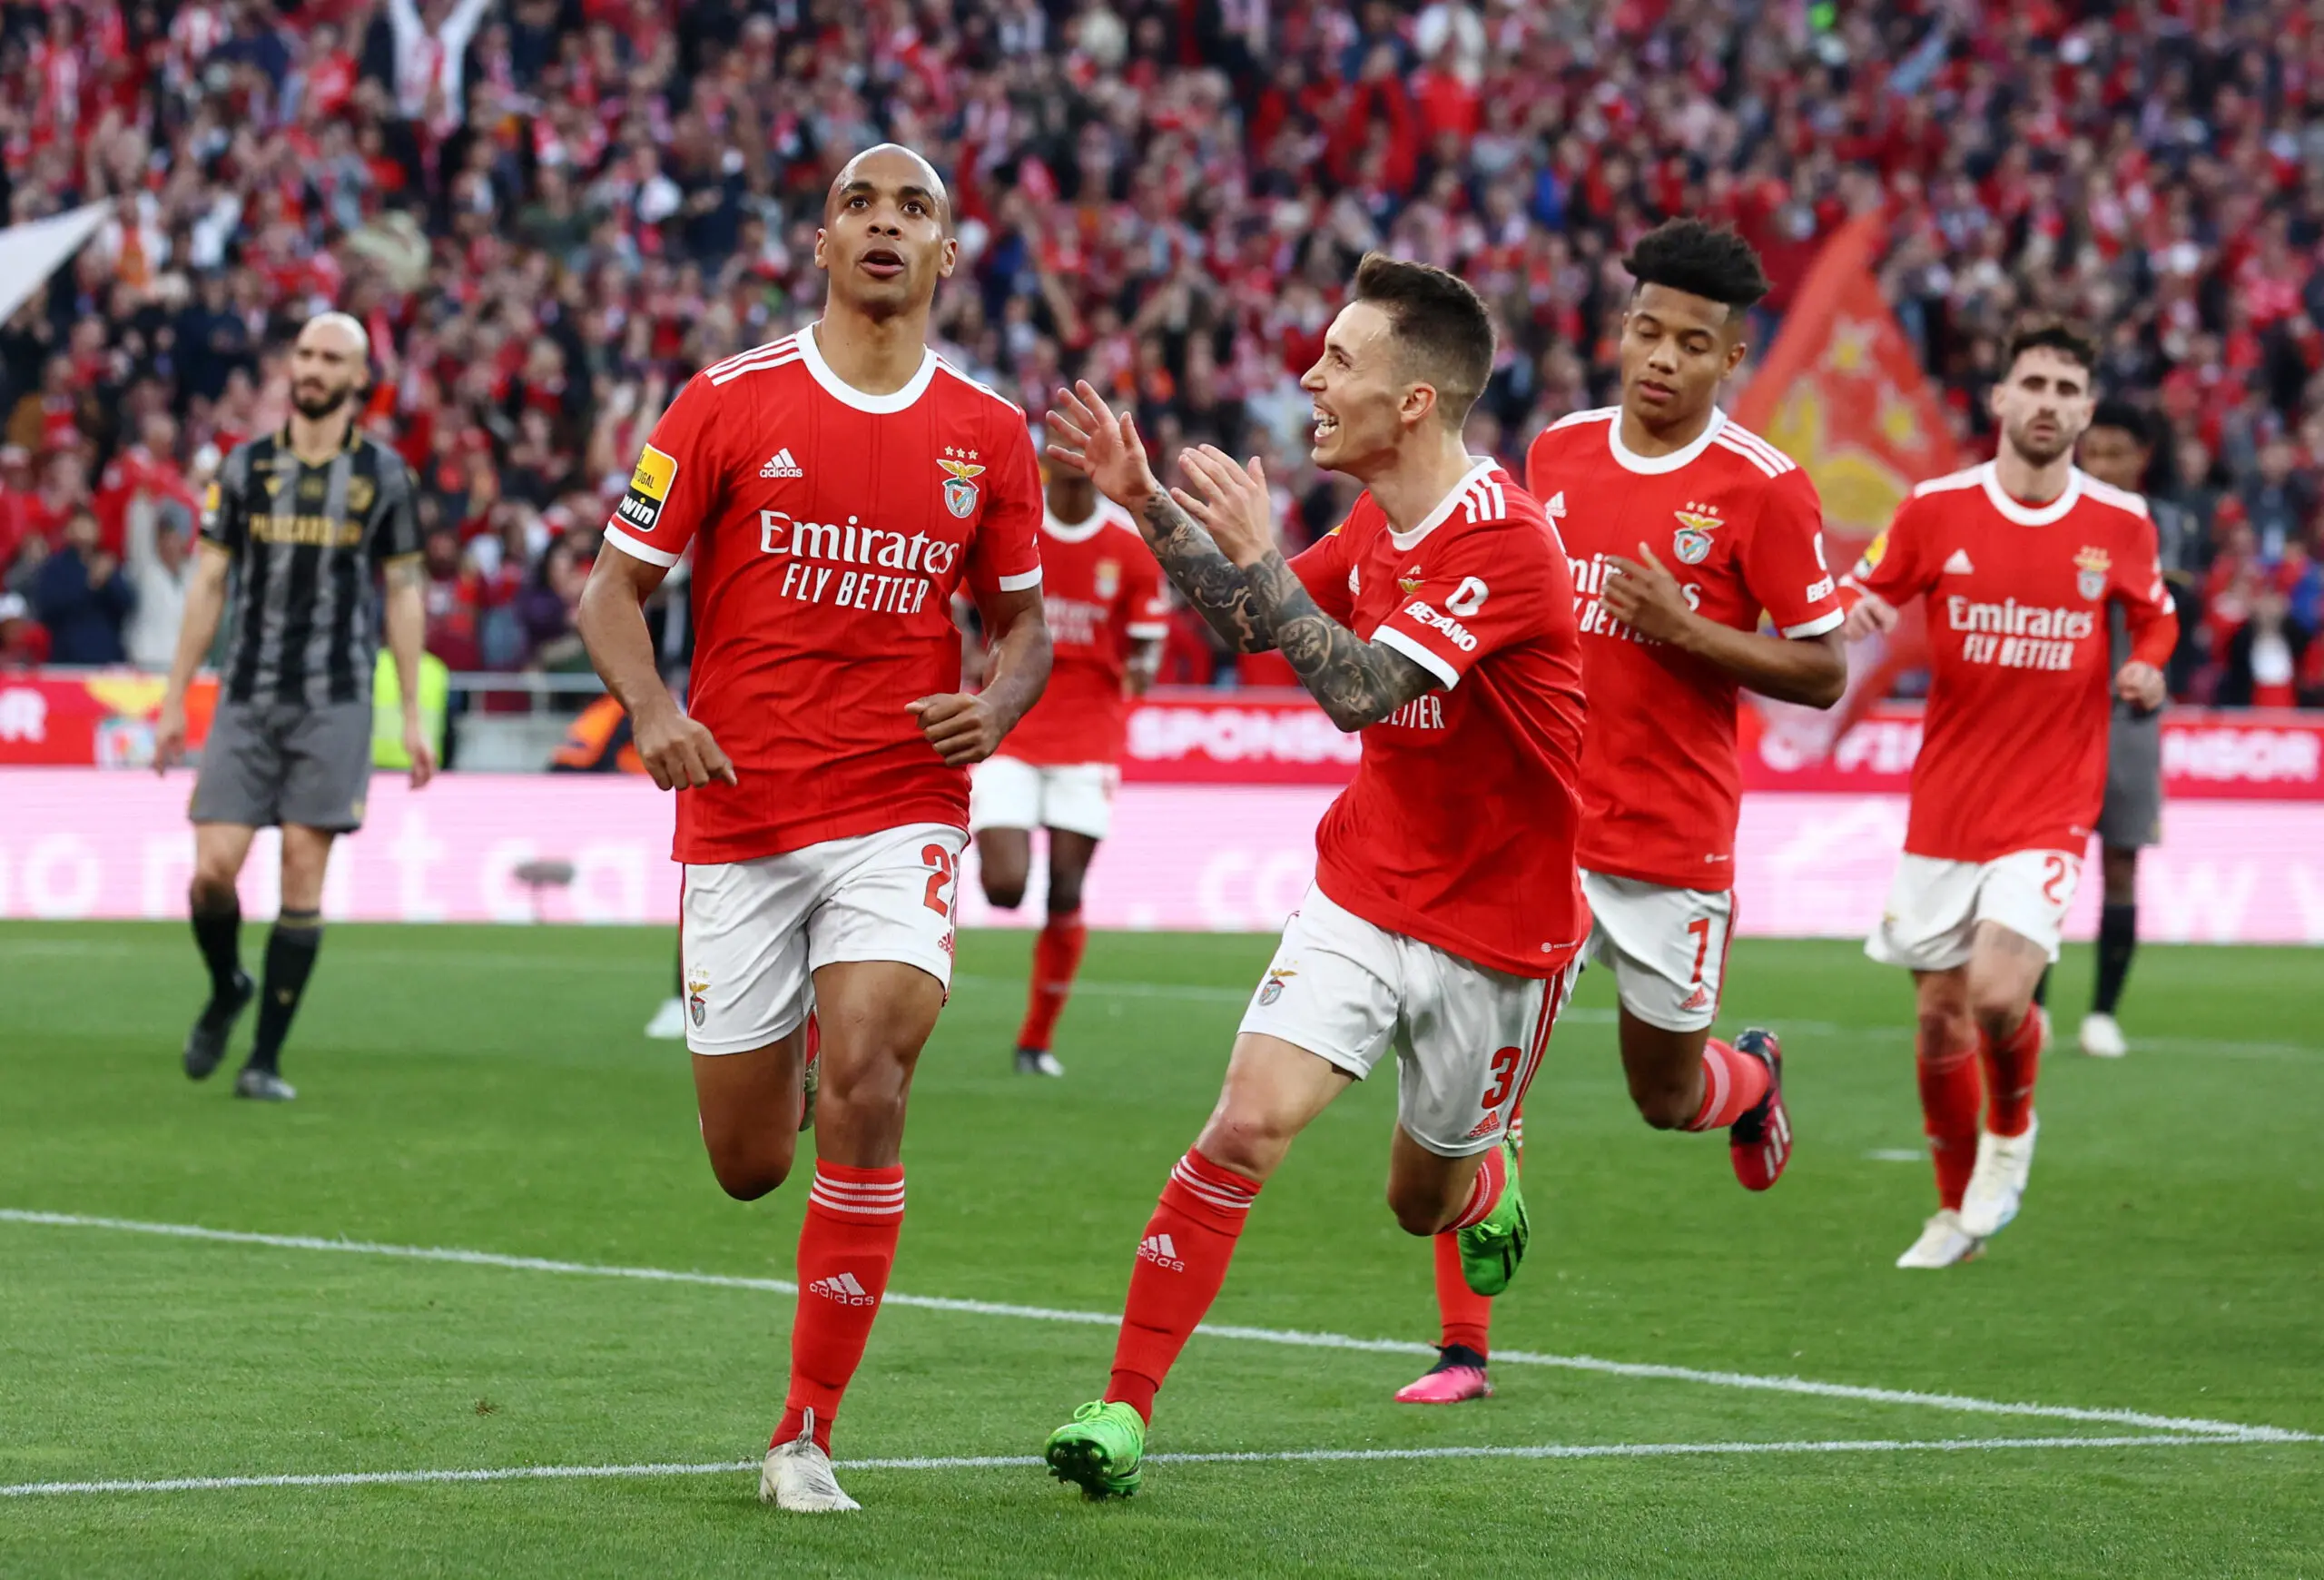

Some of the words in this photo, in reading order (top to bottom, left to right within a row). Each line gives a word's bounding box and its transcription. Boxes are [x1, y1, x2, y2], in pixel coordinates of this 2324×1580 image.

[759, 467, 803, 479] adidas
[759, 509, 960, 574] Emirates
[780, 562, 832, 604] FLY
[834, 571, 930, 614] BETTER
[1403, 600, 1478, 652] BETANO
[1947, 594, 2094, 639] Emirates
[1963, 633, 1999, 664] FLY
[1998, 637, 2075, 671] BETTER
[921, 844, 959, 919] 2
[2043, 855, 2082, 906] 2
[1481, 1046, 1522, 1110] 3
[809, 1281, 875, 1307] adidas
